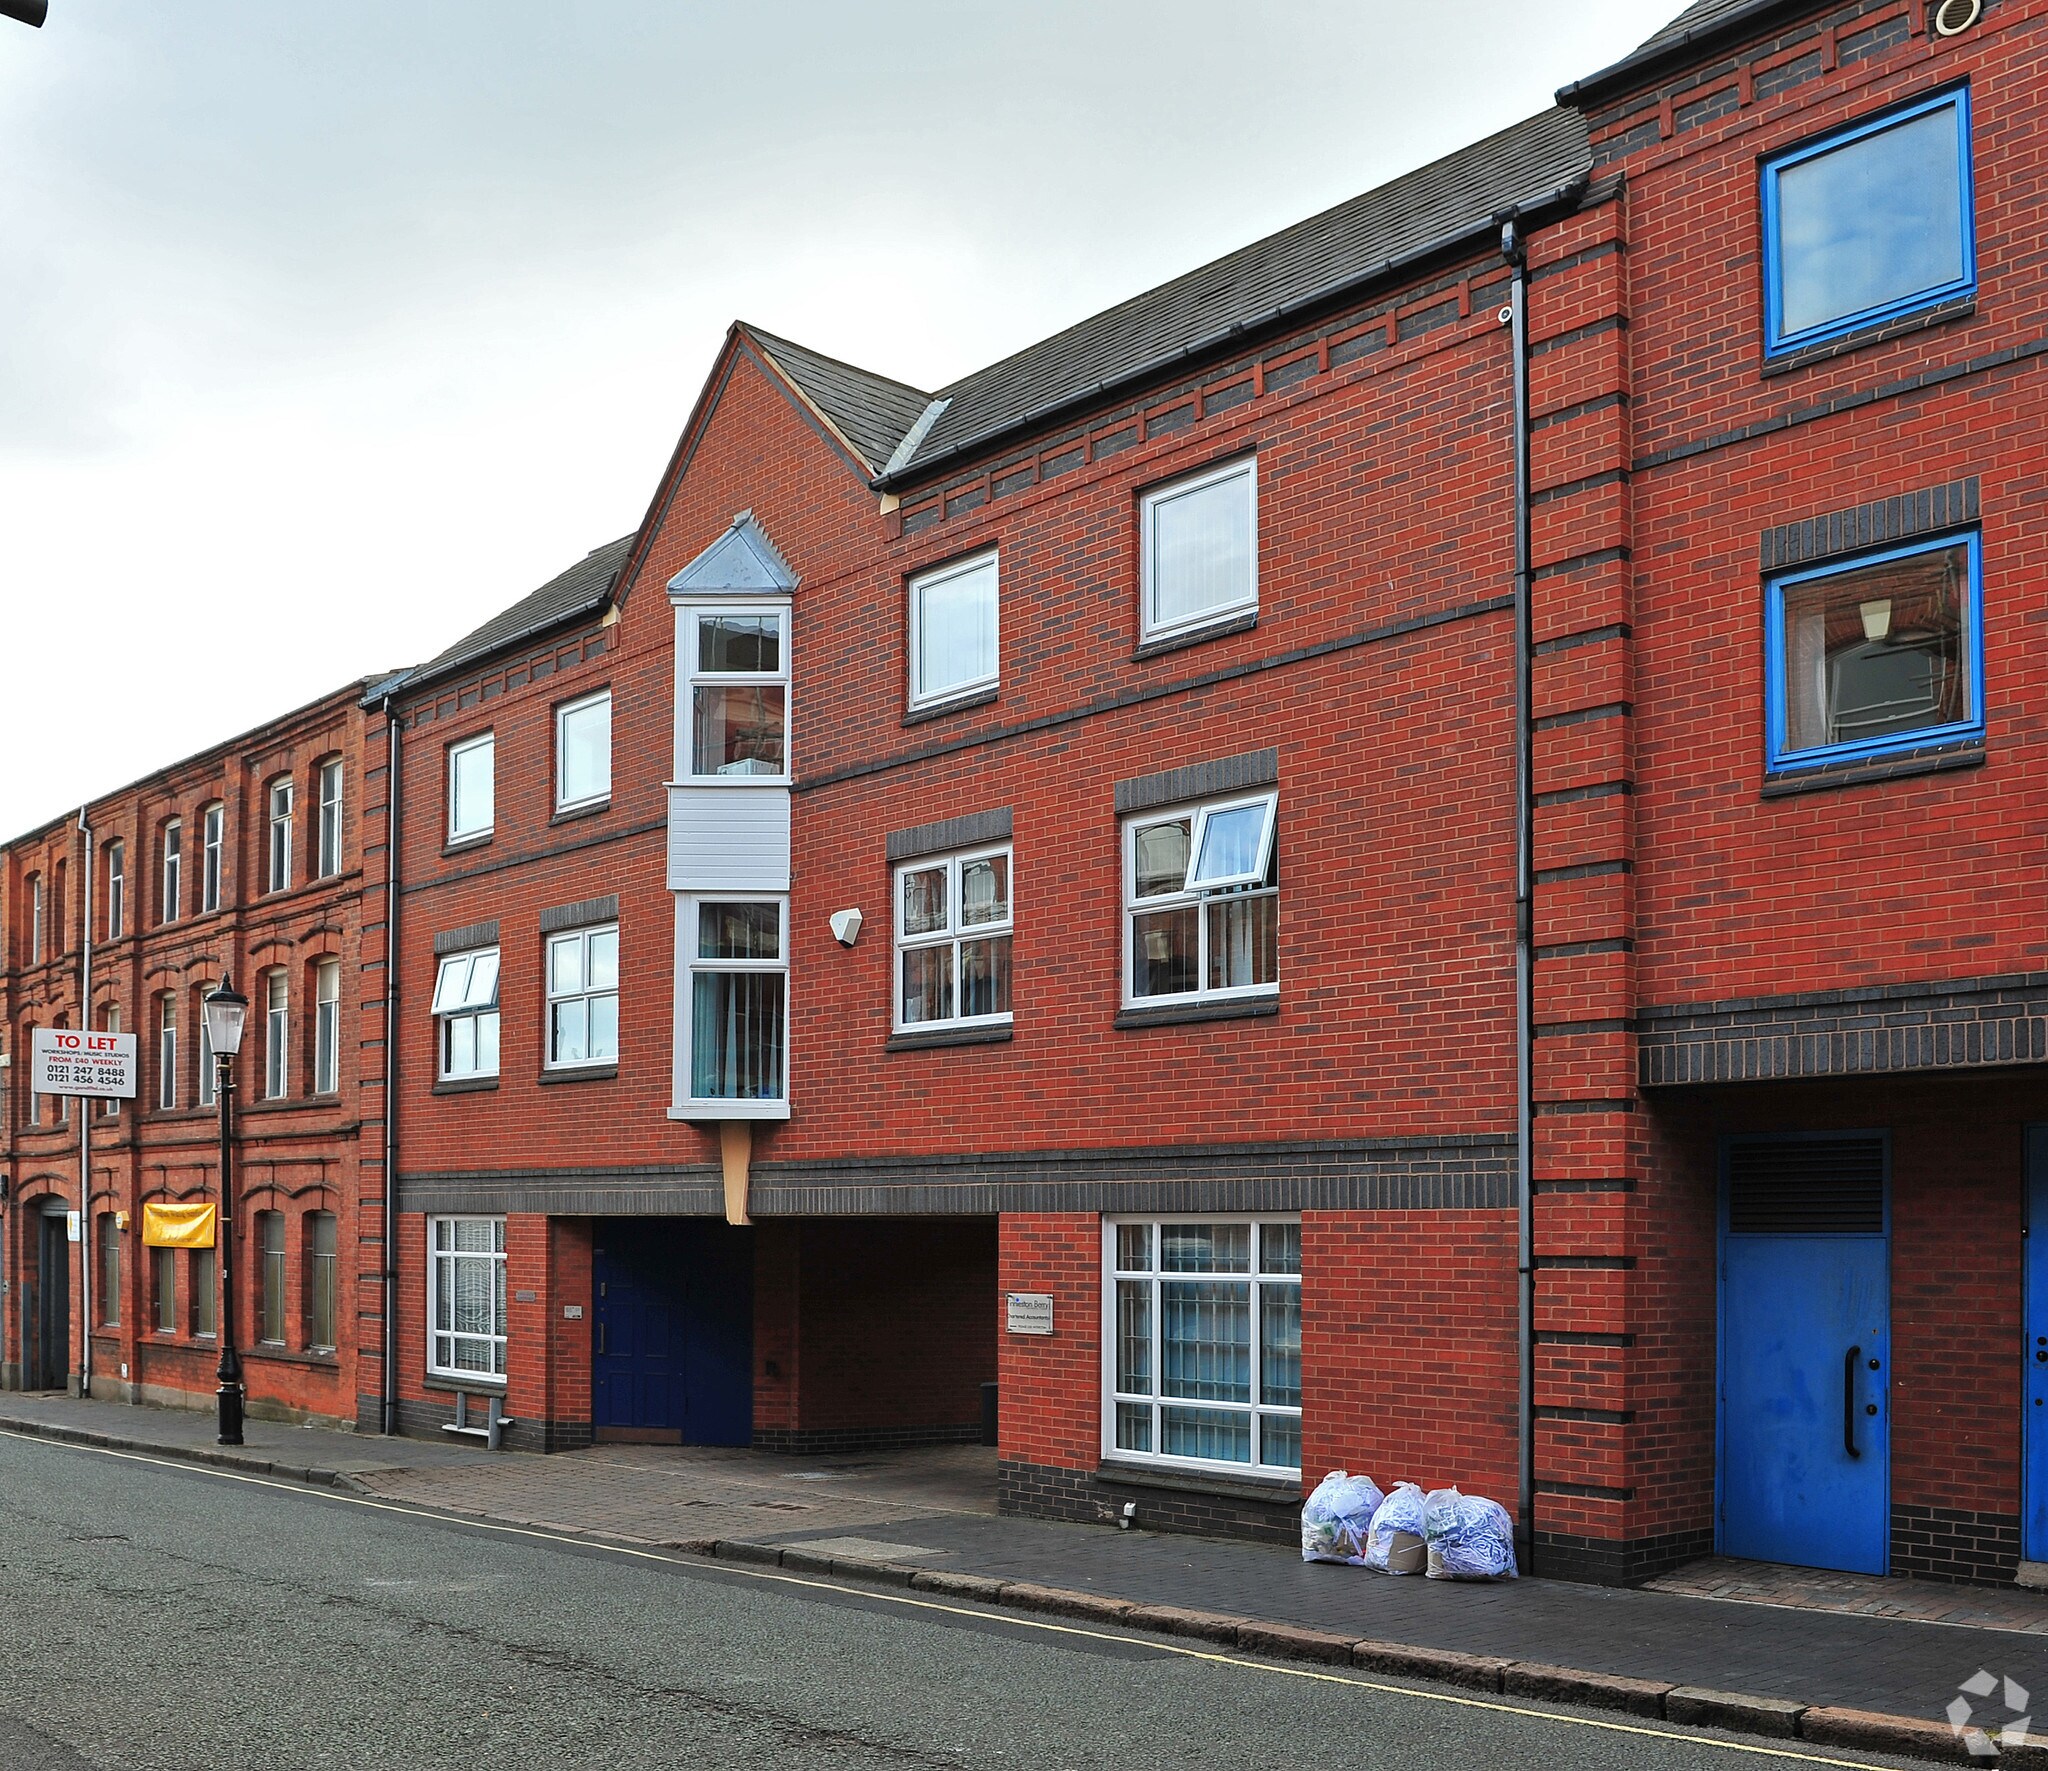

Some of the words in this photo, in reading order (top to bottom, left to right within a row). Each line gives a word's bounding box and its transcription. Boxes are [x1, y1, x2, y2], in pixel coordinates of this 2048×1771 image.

[55, 1035, 80, 1048] TO
[88, 1036, 117, 1050] LET
[47, 1065, 69, 1073] 0121
[73, 1066, 93, 1075] 247
[98, 1068, 125, 1077] 8488
[47, 1073, 69, 1082] 0121
[73, 1075, 93, 1084] 456
[98, 1077, 125, 1085] 4546
